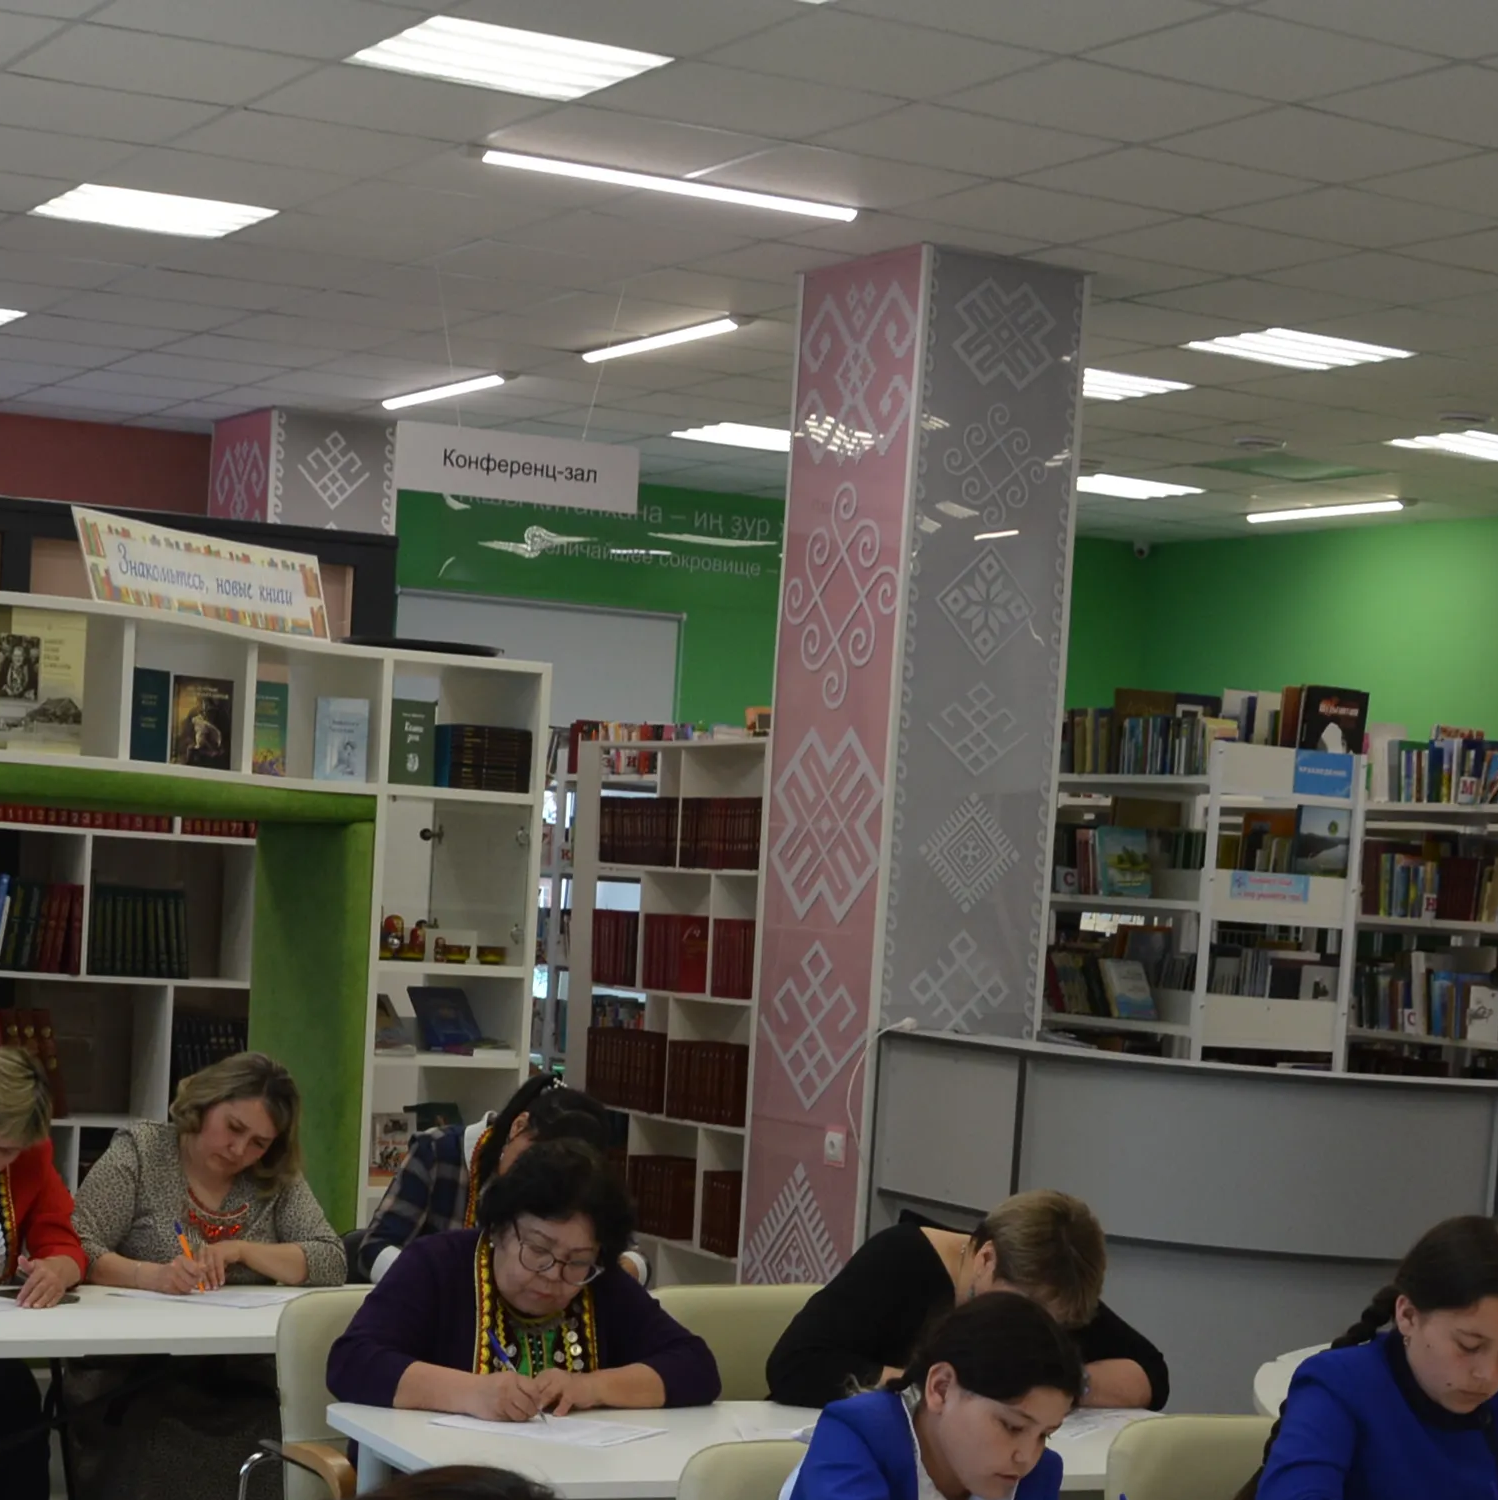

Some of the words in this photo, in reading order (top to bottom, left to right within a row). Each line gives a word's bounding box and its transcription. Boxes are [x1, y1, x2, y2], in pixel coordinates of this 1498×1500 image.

[442, 448, 598, 484] Конференц-зал
[117, 542, 209, 594] Знакомьтесь,
[216, 576, 253, 600] новые
[259, 583, 293, 606] книги
[537, 540, 654, 565] еличайшее
[659, 552, 761, 577] сокровище
